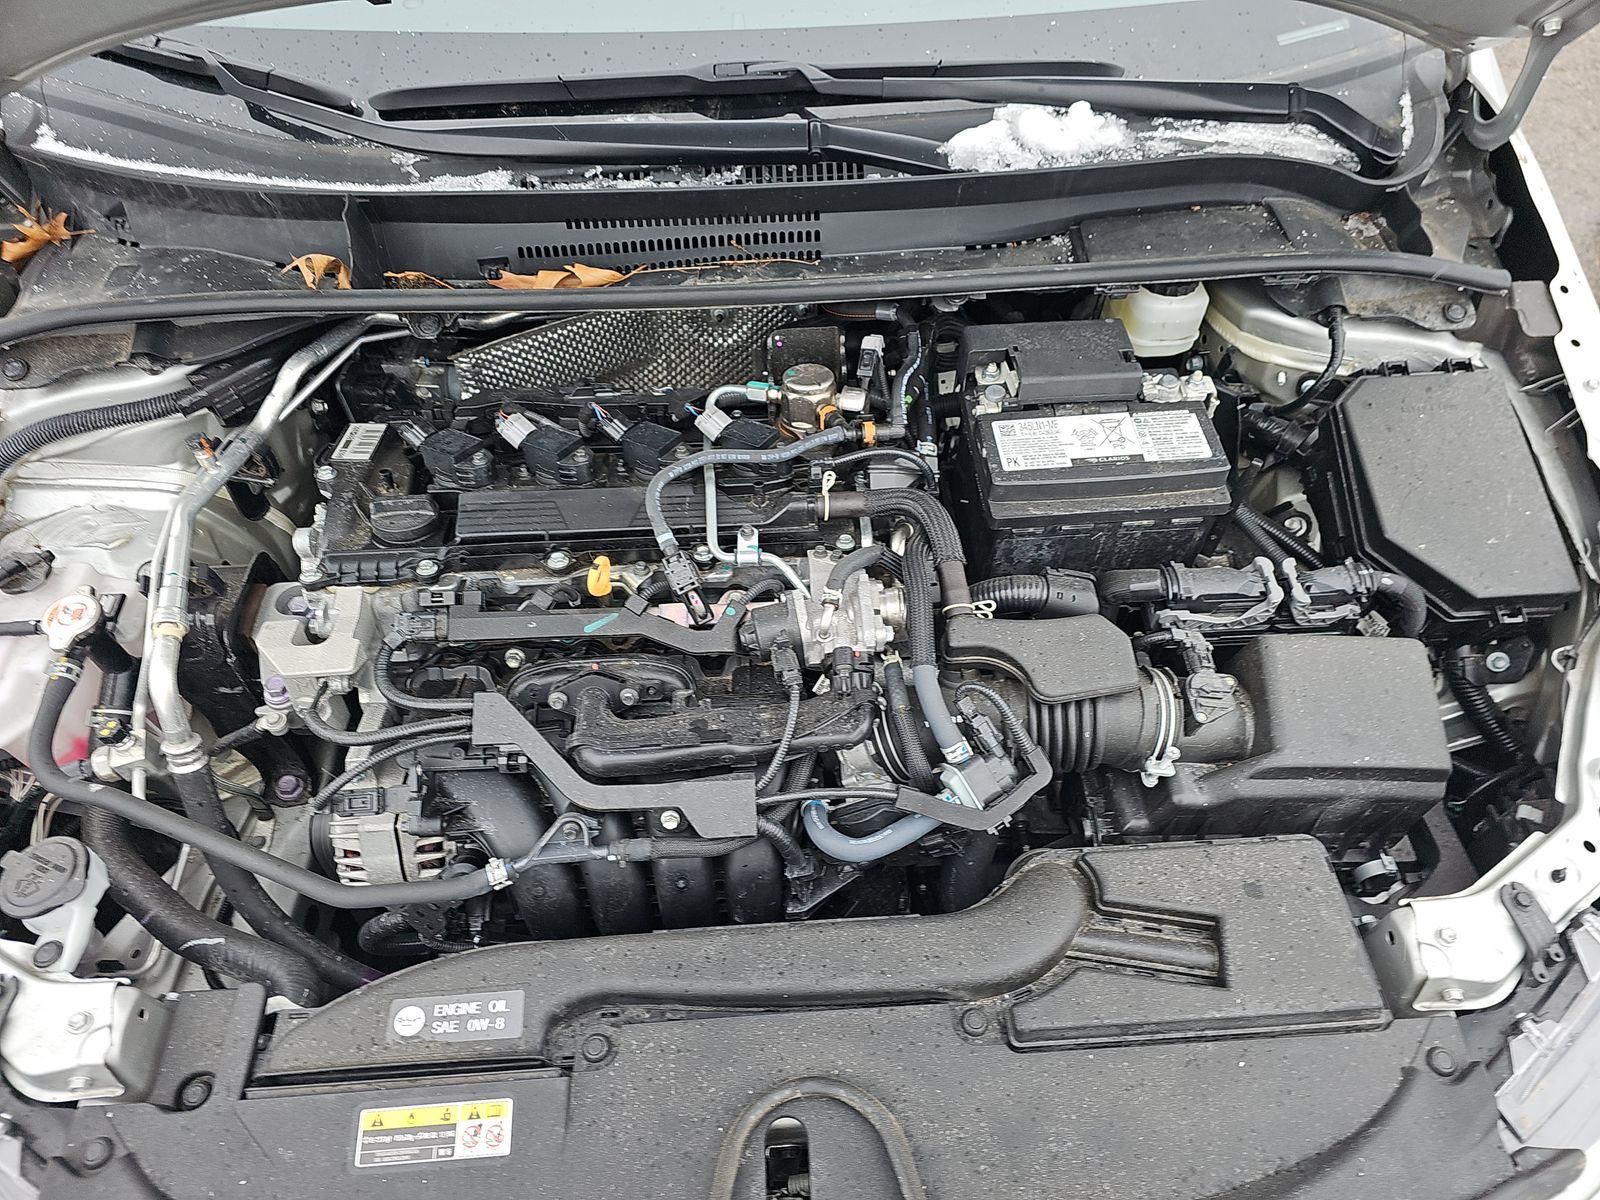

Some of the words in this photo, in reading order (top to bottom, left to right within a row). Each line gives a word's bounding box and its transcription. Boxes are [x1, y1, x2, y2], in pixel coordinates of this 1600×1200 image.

[1006, 457, 1021, 467] PK
[433, 1001, 483, 1017] ENGINE
[488, 999, 511, 1013] OIL
[430, 1020, 460, 1034] SAE
[466, 1017, 506, 1032] 0W-8
